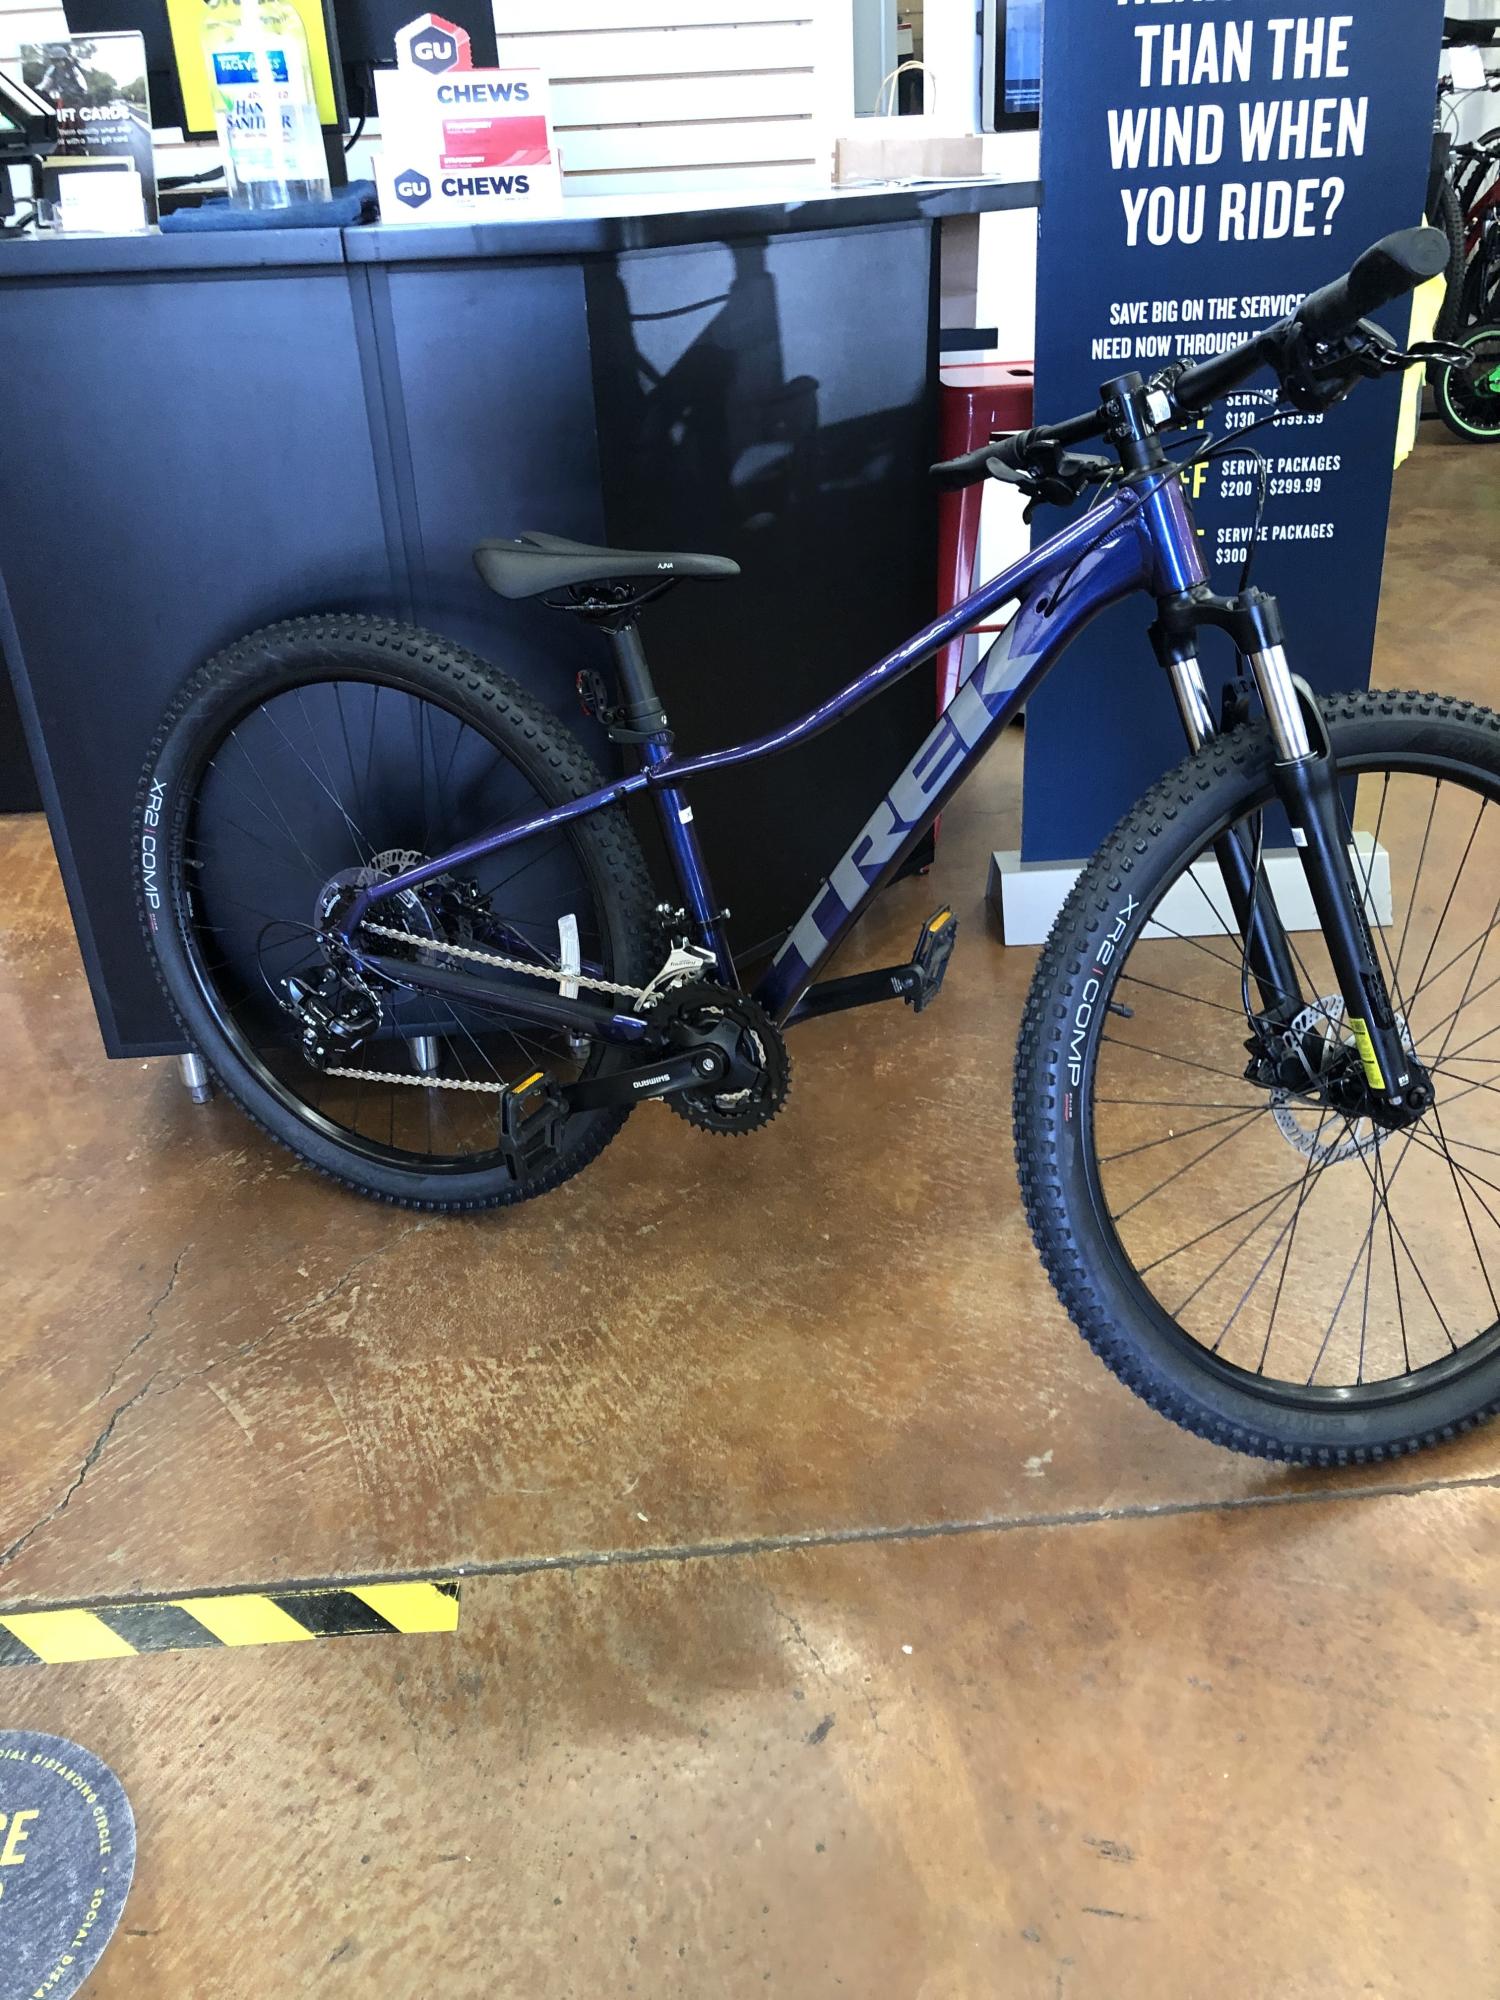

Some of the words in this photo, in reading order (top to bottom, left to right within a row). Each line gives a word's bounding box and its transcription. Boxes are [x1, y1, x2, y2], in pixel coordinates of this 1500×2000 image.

[414, 42, 452, 60] GU
[1134, 20, 1253, 87] THAN
[1268, 16, 1353, 81] THE
[437, 82, 530, 104] CHEWS
[56, 108, 76, 122] IFT
[1107, 104, 1225, 170] WIND
[1239, 97, 1368, 163] WHEN
[398, 181, 427, 197] GU
[441, 175, 530, 197] CHEWS
[1120, 184, 1206, 247] YOU
[1218, 176, 1345, 242] RIDE?
[1110, 302, 1149, 325] SAVE
[1151, 300, 1178, 323] BIG
[1181, 299, 1203, 321] ON
[1208, 297, 1238, 320] THE
[1091, 337, 1132, 360] NEED
[1135, 335, 1172, 358] NOW
[1174, 331, 1248, 357] THROUGH
[1225, 411, 1256, 430] $130
[1277, 455, 1341, 474] PACKAGES
[1220, 480, 1253, 498] $200
[1269, 477, 1322, 496] $299.99
[1272, 523, 1335, 541] PACKAGES
[1216, 547, 1248, 565] $300
[144, 777, 167, 827] XR2
[772, 612, 1043, 969] TREK
[142, 835, 161, 909] COMP
[1096, 894, 1140, 965] XR2
[1067, 978, 1100, 1087] COMP
[632, 1073, 671, 1089] SHIMANO
[31, 1753, 98, 1804] DISTANCING
[93, 1806, 112, 1856] CIRCLE
[71, 1888, 105, 1948] SOCIAL
